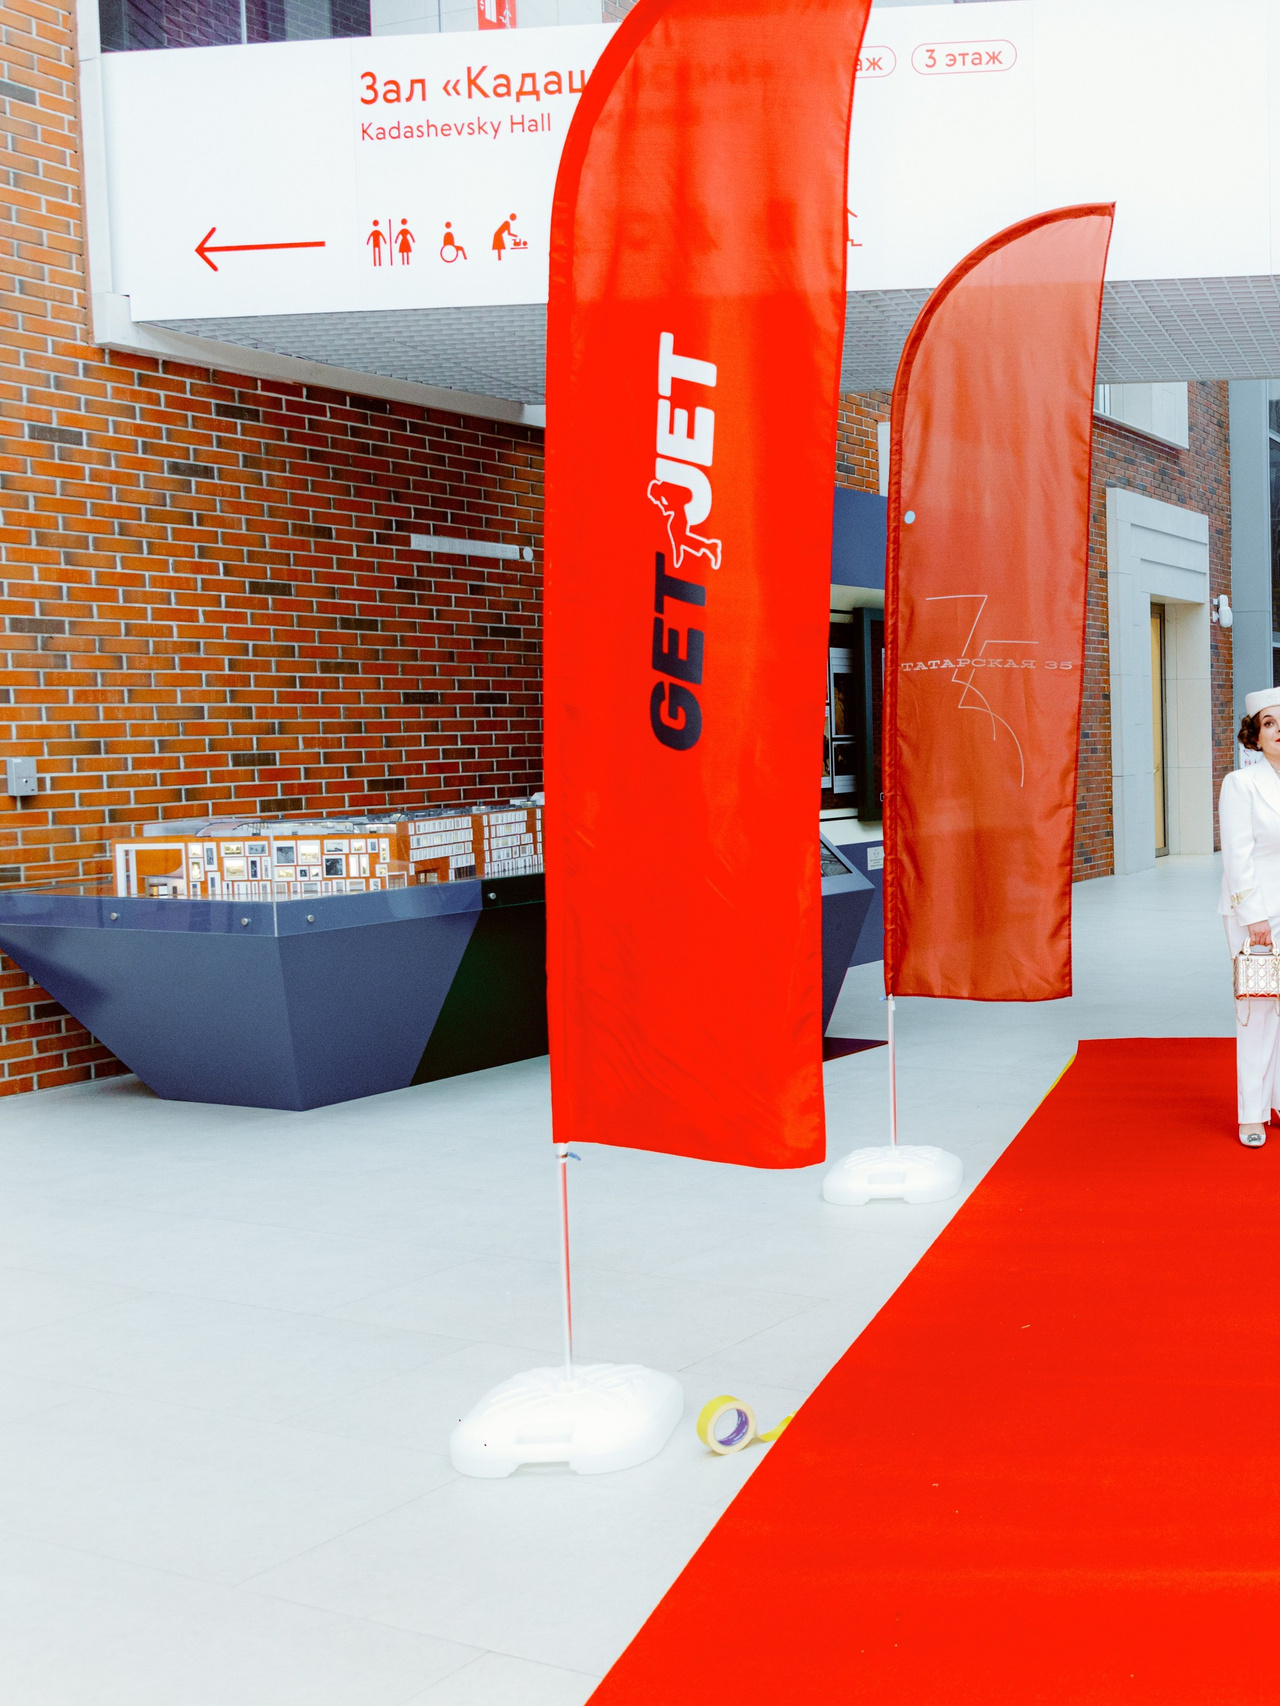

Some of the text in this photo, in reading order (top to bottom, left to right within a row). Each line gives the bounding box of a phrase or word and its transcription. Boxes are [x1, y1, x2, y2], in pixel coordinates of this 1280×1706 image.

[924, 49, 1004, 68] 3 этаж
[360, 71, 427, 105] Зал
[361, 112, 551, 141] Kadashevsky Hall
[649, 331, 718, 752] GET JET
[901, 658, 1073, 672] ТАТАРСКАЯ 35
